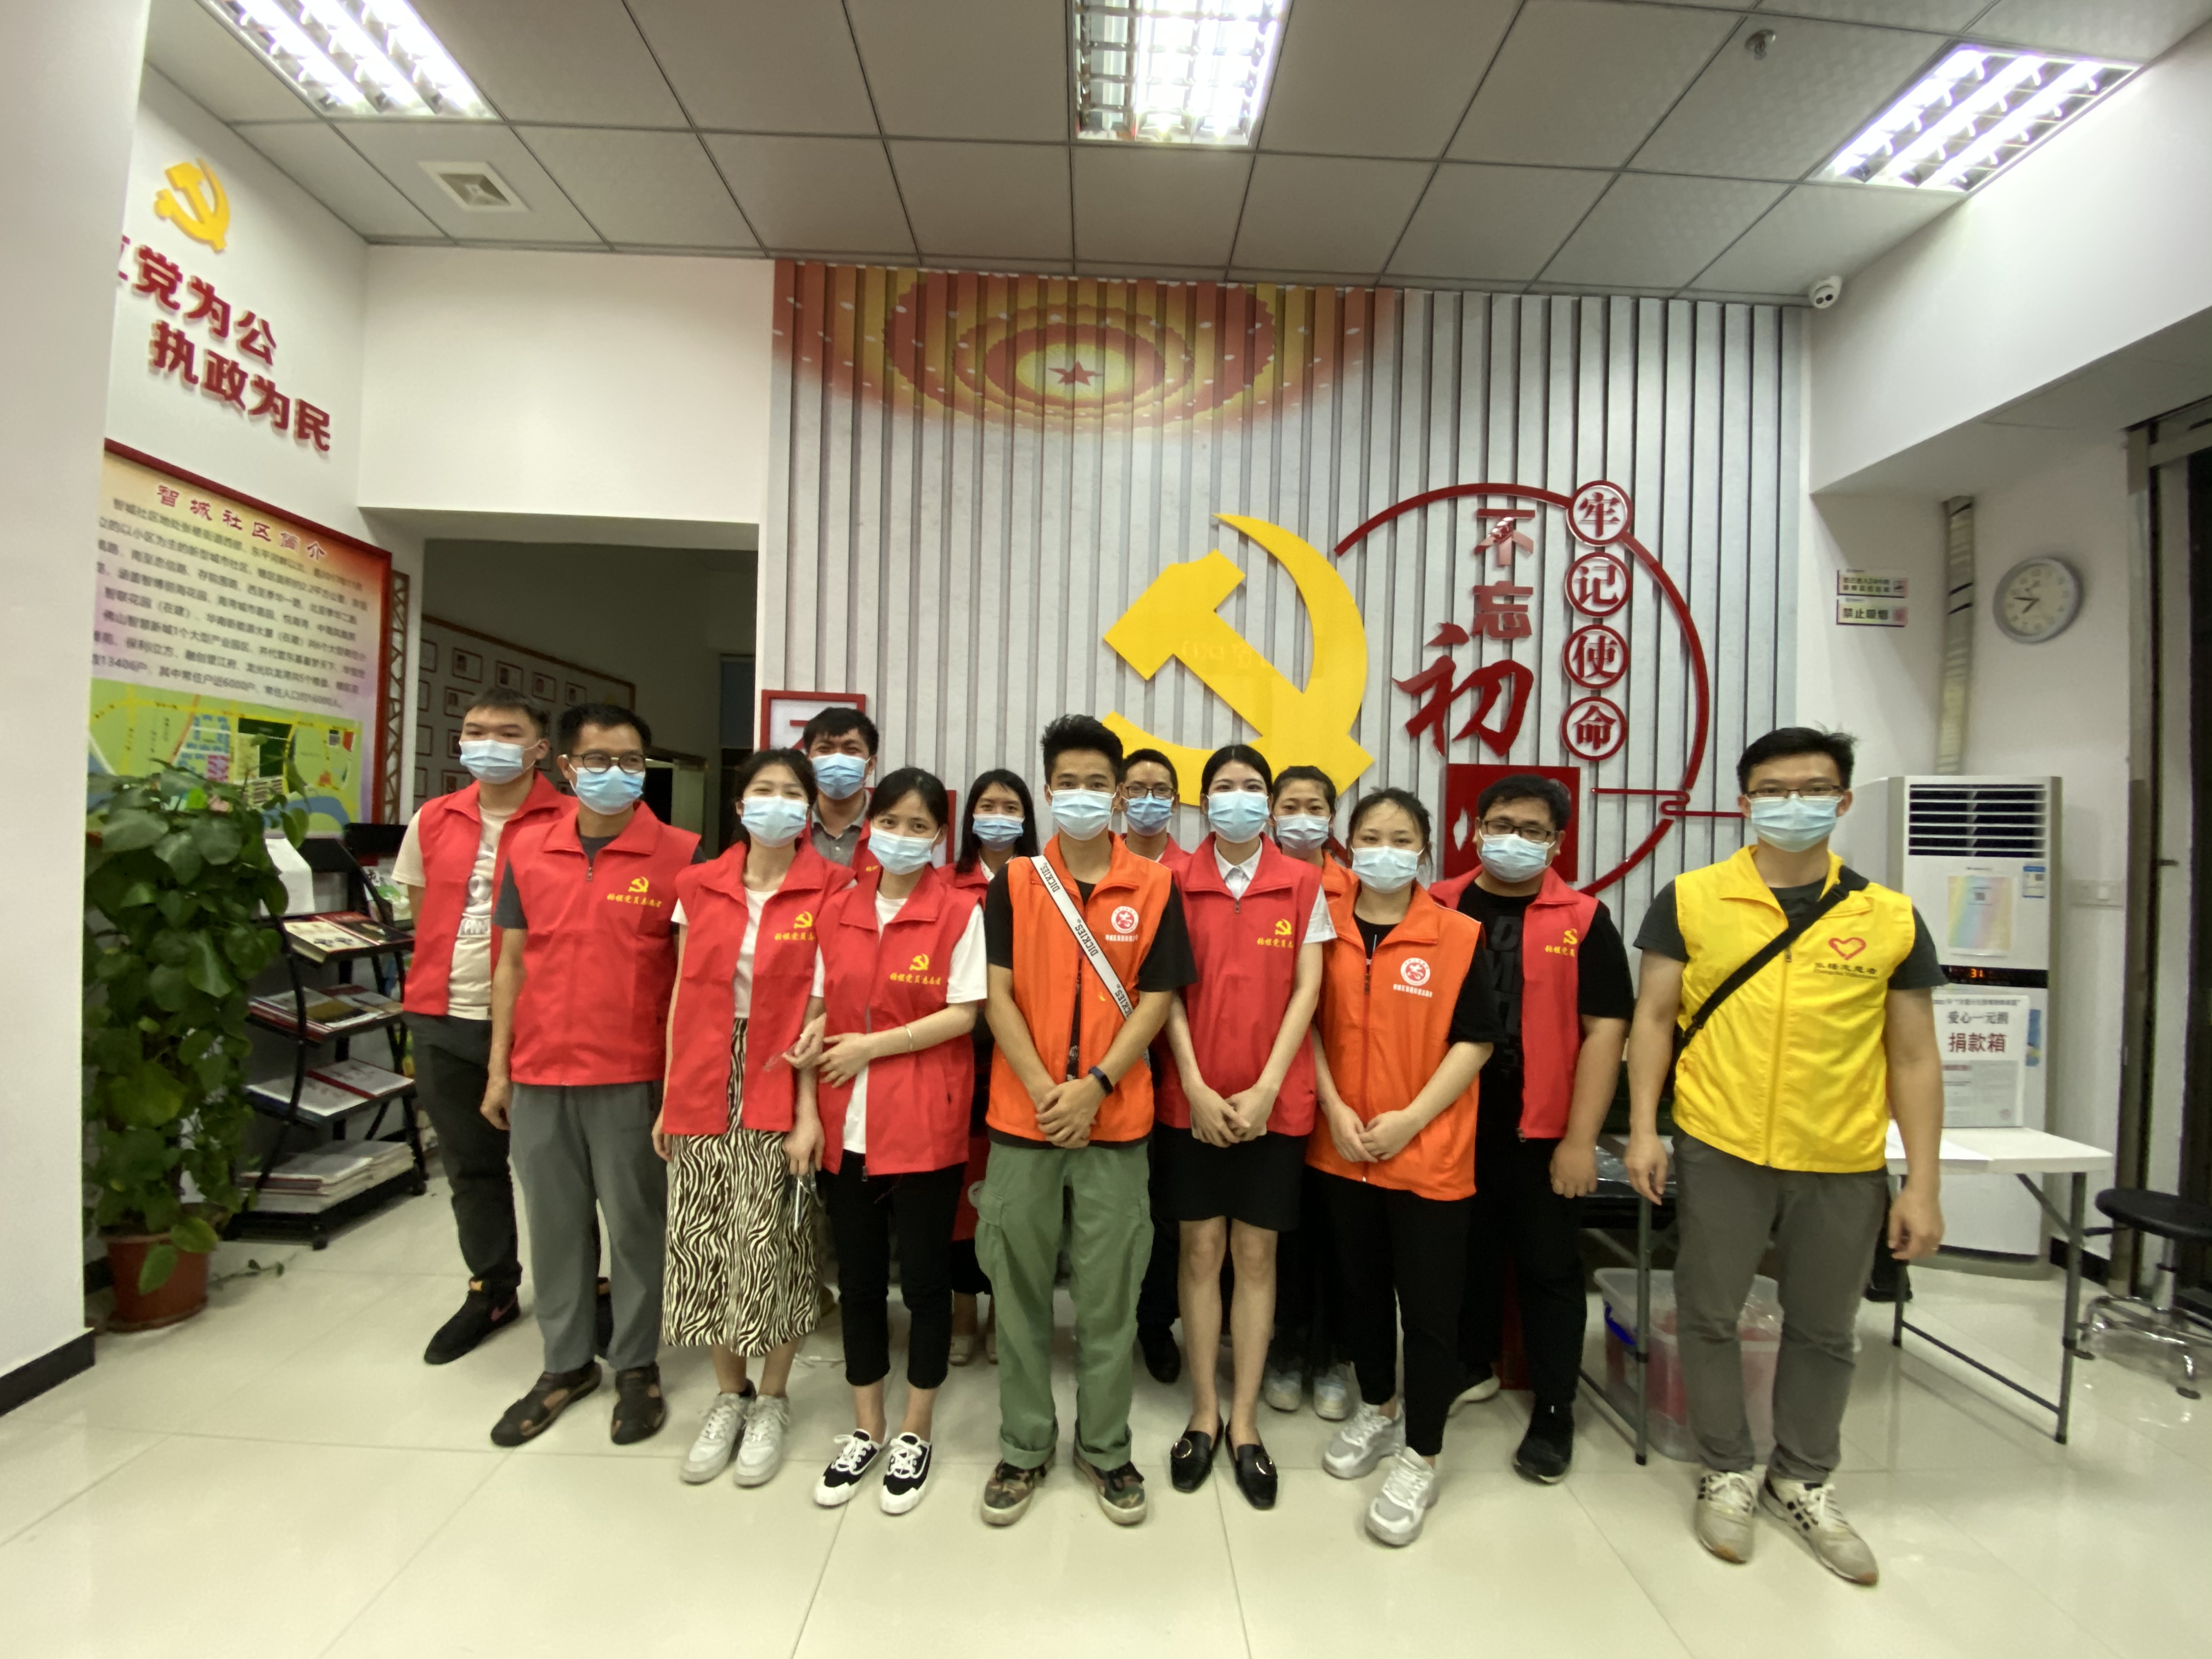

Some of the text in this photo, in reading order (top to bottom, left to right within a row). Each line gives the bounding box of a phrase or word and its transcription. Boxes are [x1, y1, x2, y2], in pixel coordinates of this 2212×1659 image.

[119, 235, 276, 365] 党为公
[151, 320, 330, 452] 执政为民
[157, 485, 326, 561] 智城社区简介
[1572, 493, 1620, 750] 牢记使命
[1040, 865, 1060, 892] DICKIES
[1075, 924, 1098, 956] DICKIES
[1115, 989, 1133, 1017] ICKIES
[1948, 1032, 2007, 1053] 捐款箱
